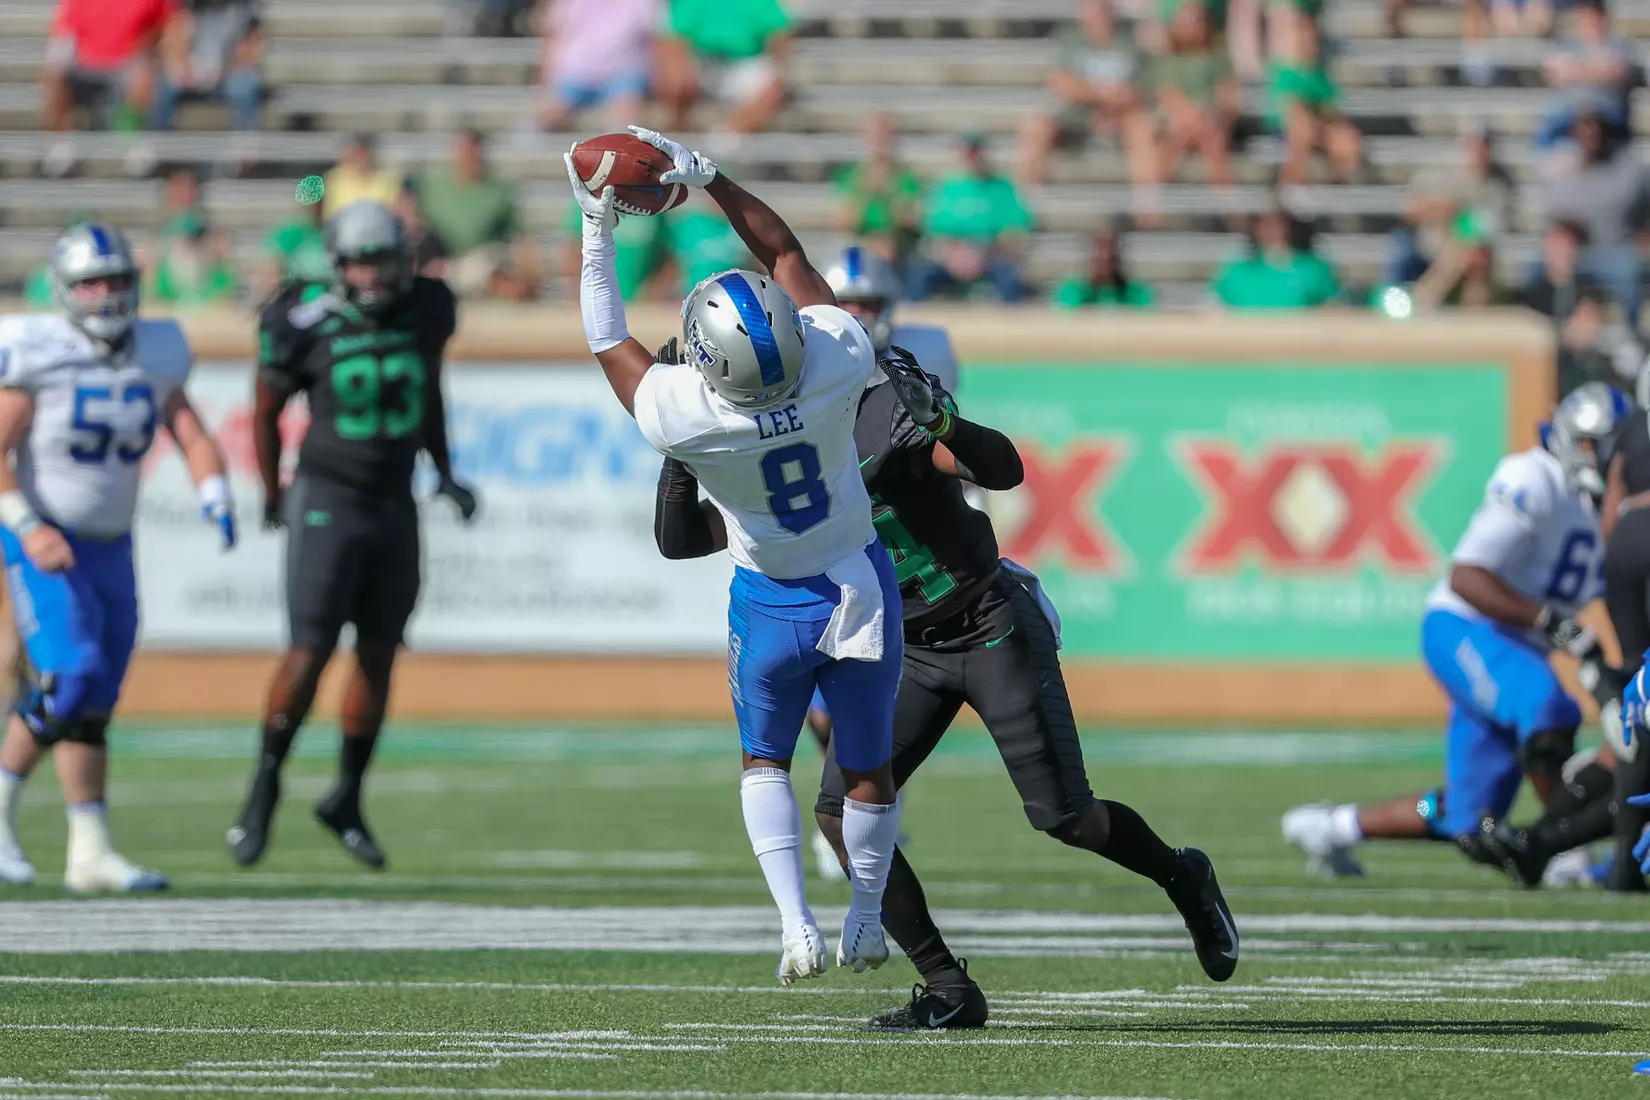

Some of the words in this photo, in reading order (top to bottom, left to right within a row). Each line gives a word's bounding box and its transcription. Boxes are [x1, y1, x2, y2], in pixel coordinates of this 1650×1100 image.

[69, 382, 156, 464] 53
[331, 353, 427, 440] 93
[754, 403, 804, 440] LEE
[758, 440, 832, 537] 8
[1546, 529, 1606, 603] 6
